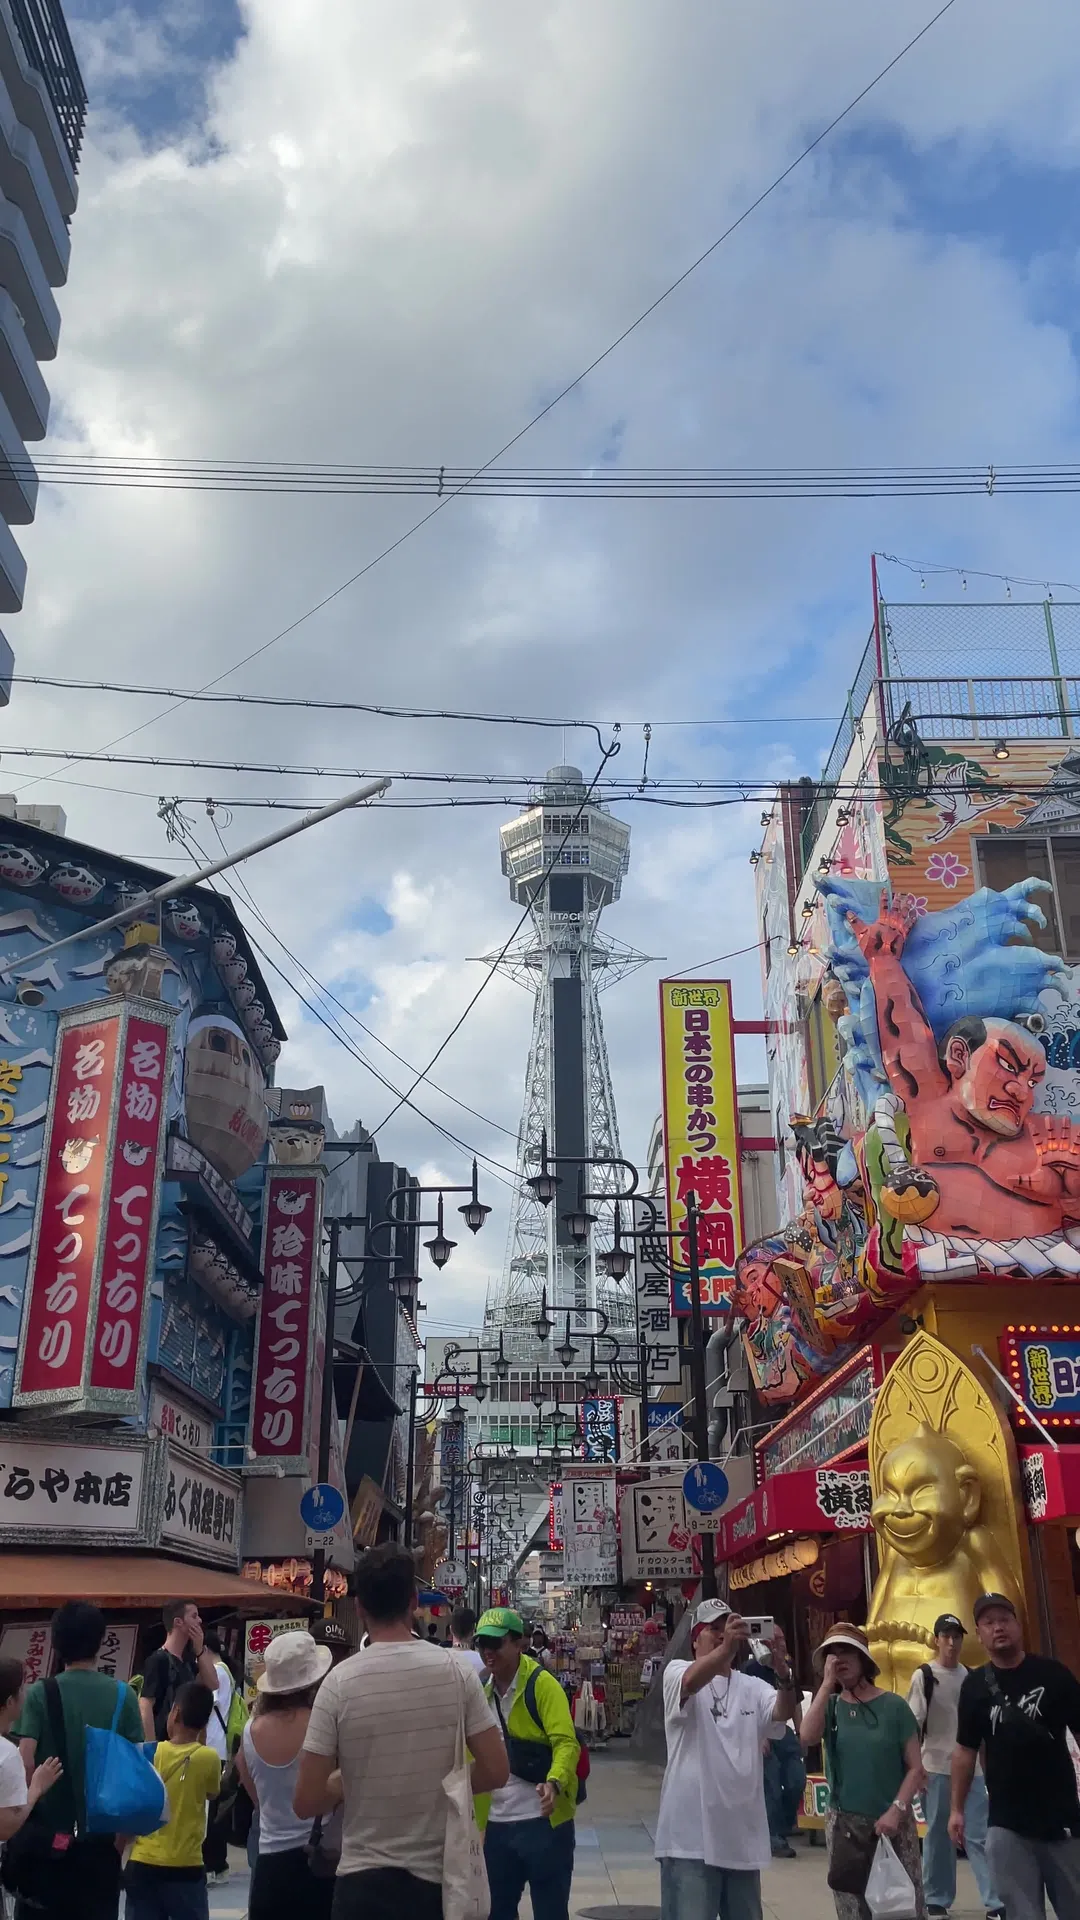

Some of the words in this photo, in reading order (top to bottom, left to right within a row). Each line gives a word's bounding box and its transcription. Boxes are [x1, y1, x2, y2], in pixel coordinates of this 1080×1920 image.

[671, 988, 720, 1007] 新世界
[66, 1038, 106, 1124] 名物
[124, 1038, 161, 1123] 名物
[684, 1010, 717, 1152] 日本一の串かつ
[676, 1156, 734, 1268] 横綱
[38, 1183, 91, 1370] てっちり
[99, 1185, 149, 1370] てっちり
[260, 1222, 306, 1447] 珍味てっちり
[1028, 1348, 1053, 1407] 新世界
[0, 1463, 132, 1507] らや本店
[164, 1470, 235, 1544] ふぐ料理専門
[692, 1519, 719, 1530] 9-22
[307, 1536, 334, 1546] 9-22
